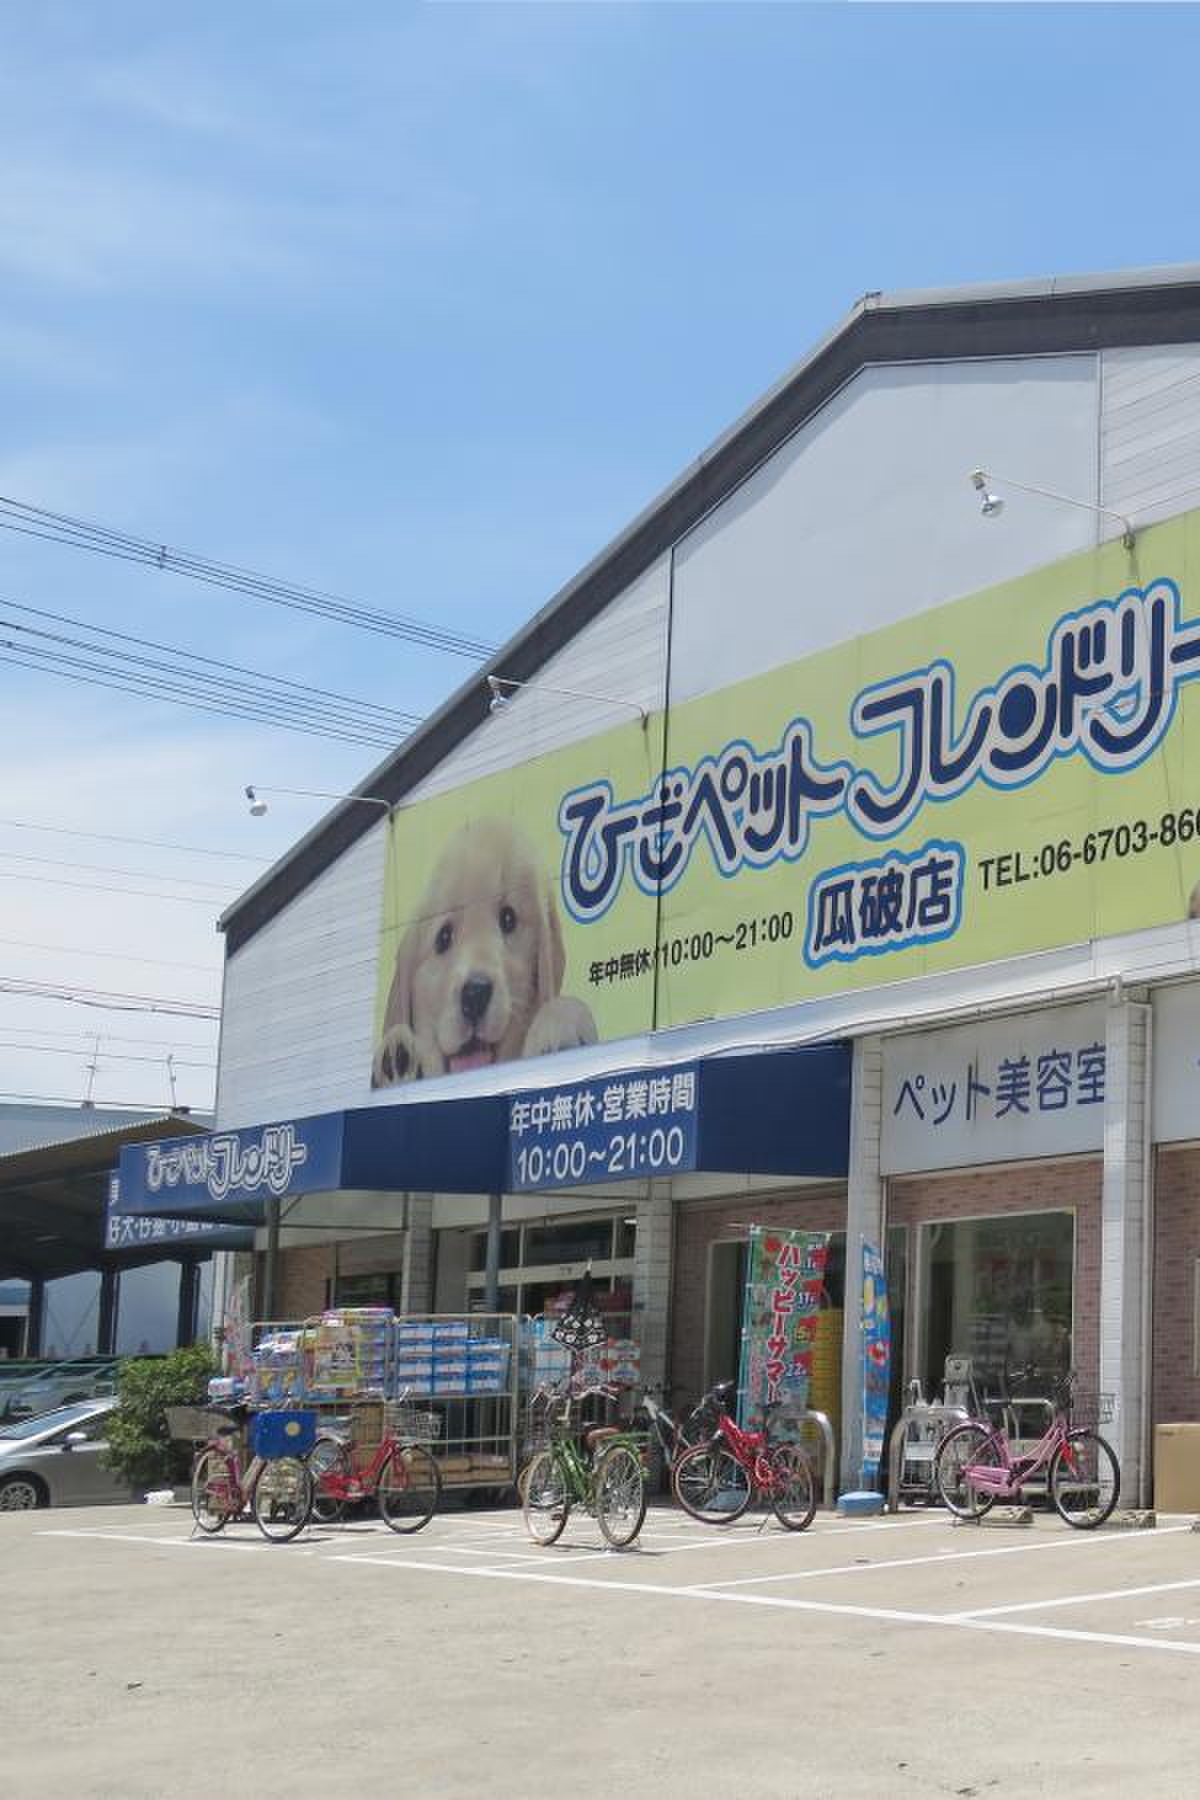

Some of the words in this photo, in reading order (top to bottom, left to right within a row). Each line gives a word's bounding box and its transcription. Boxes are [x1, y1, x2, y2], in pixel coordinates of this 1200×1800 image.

[812, 855, 956, 955] 瓜破店
[510, 1071, 696, 1137] 年中無休・営業時間
[893, 1043, 1106, 1125] ペット美容室
